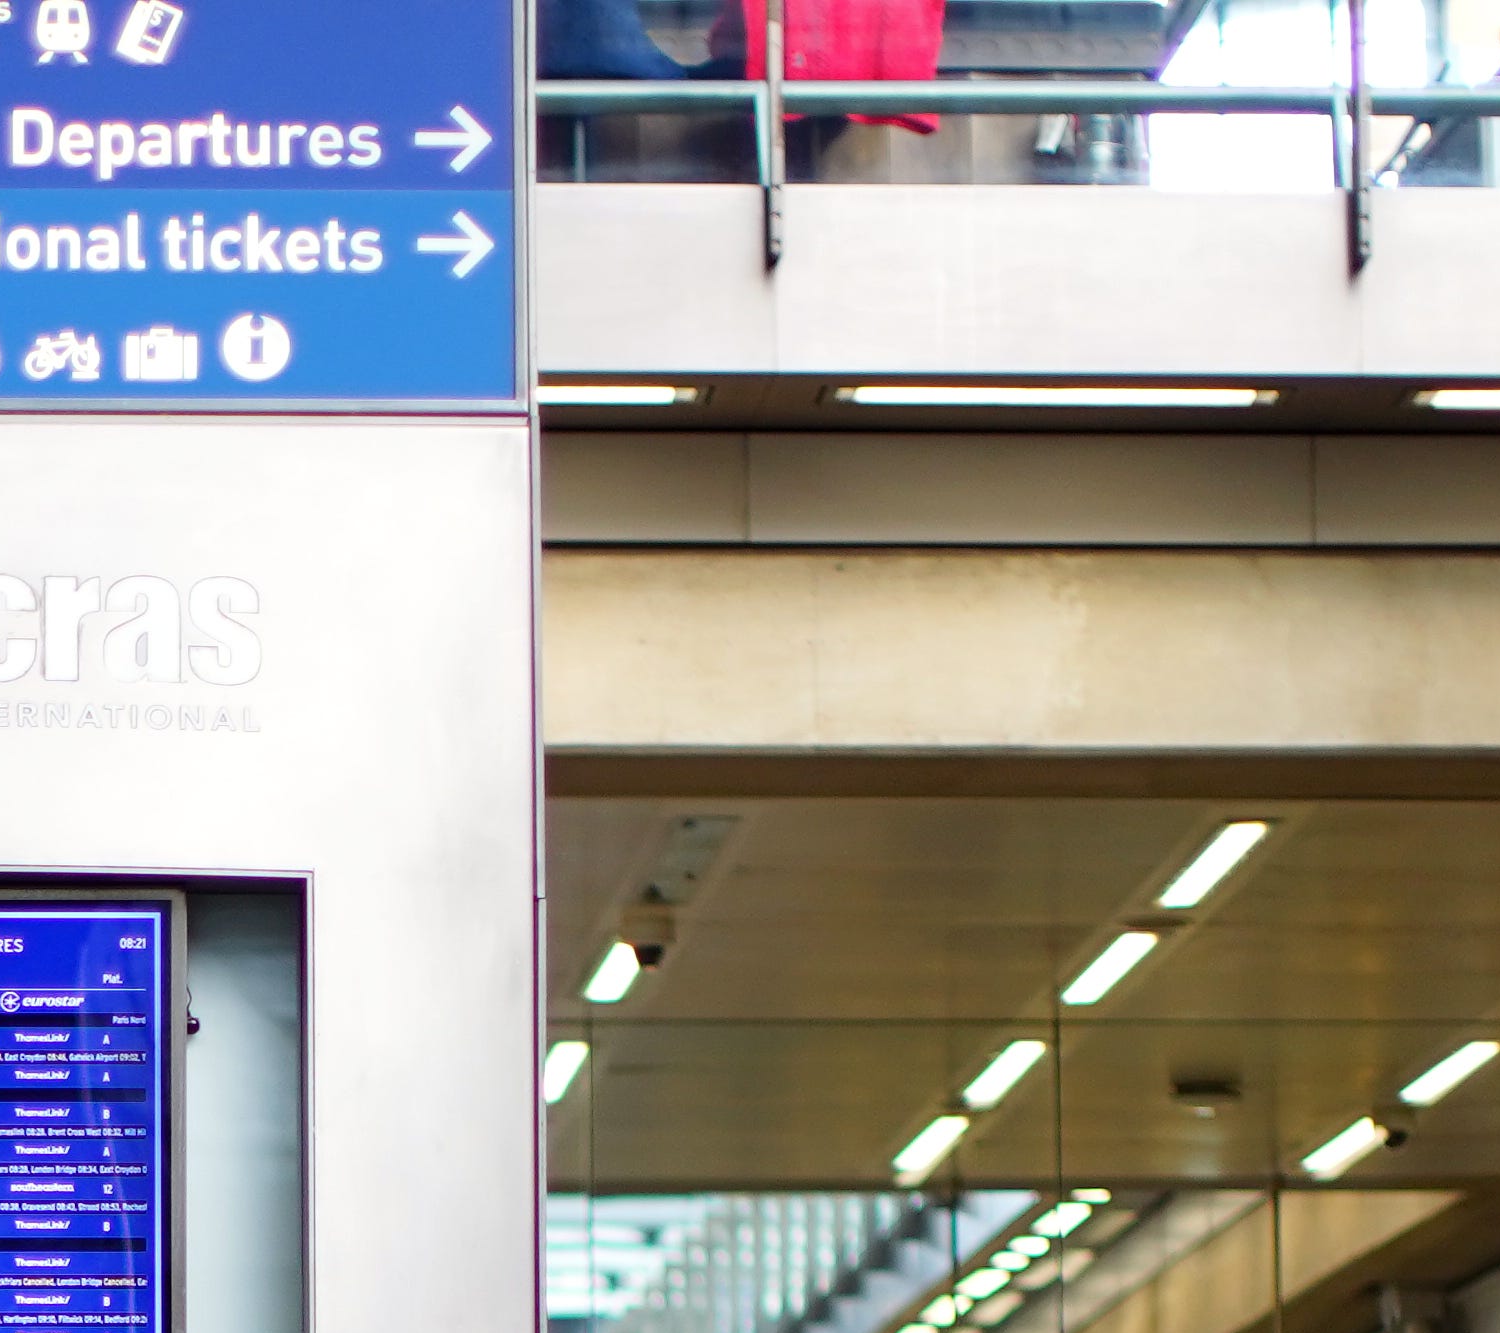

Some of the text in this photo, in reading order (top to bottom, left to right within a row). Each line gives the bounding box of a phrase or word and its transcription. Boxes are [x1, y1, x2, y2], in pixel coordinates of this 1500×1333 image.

[9, 108, 383, 181] Departures
[162, 213, 385, 274] tickets
[119, 936, 147, 950] 08:21
[21, 994, 86, 1008] eurostar
[102, 1034, 111, 1045] A
[102, 1071, 111, 1082] A
[102, 1146, 111, 1157] A
